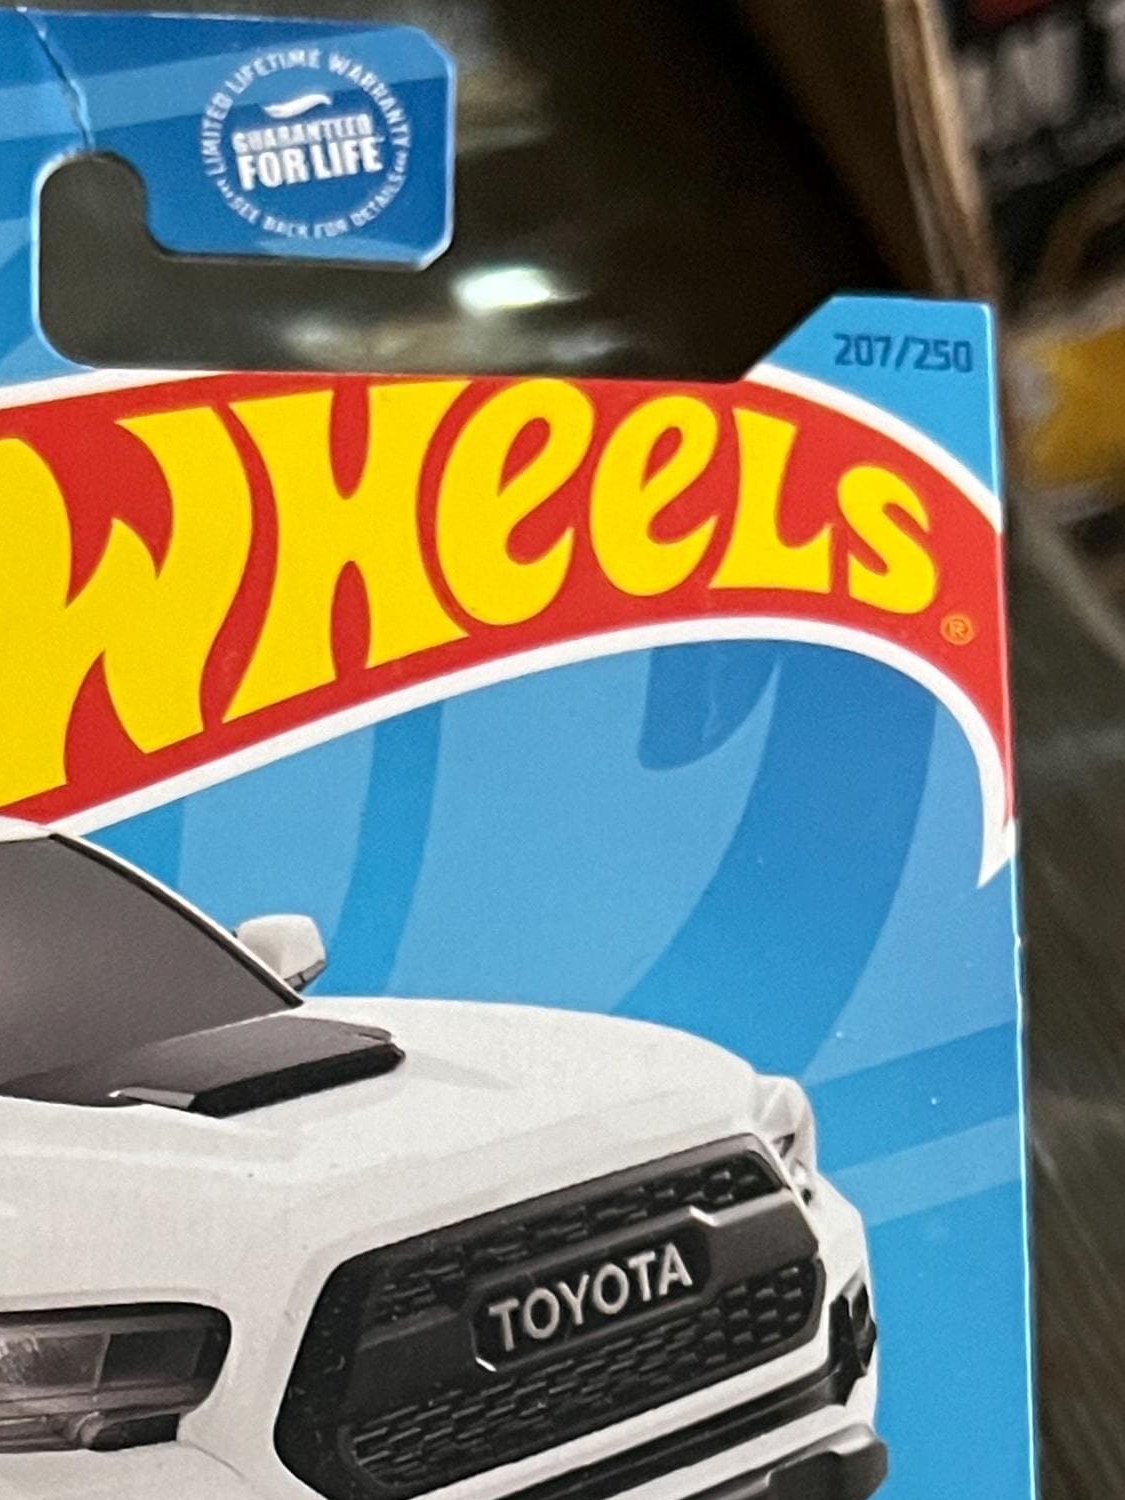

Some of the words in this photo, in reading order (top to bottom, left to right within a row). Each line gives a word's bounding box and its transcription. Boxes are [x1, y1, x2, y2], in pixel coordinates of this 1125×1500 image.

[201, 91, 234, 176] LIMITED
[225, 48, 321, 94] LIFETIME
[328, 52, 411, 147] WARRANTY
[237, 146, 310, 192] FOR
[309, 136, 384, 181] LIFE
[349, 172, 407, 228] DETAILS
[833, 333, 973, 373] 207/250
[488, 1242, 693, 1352] TOYOTA
